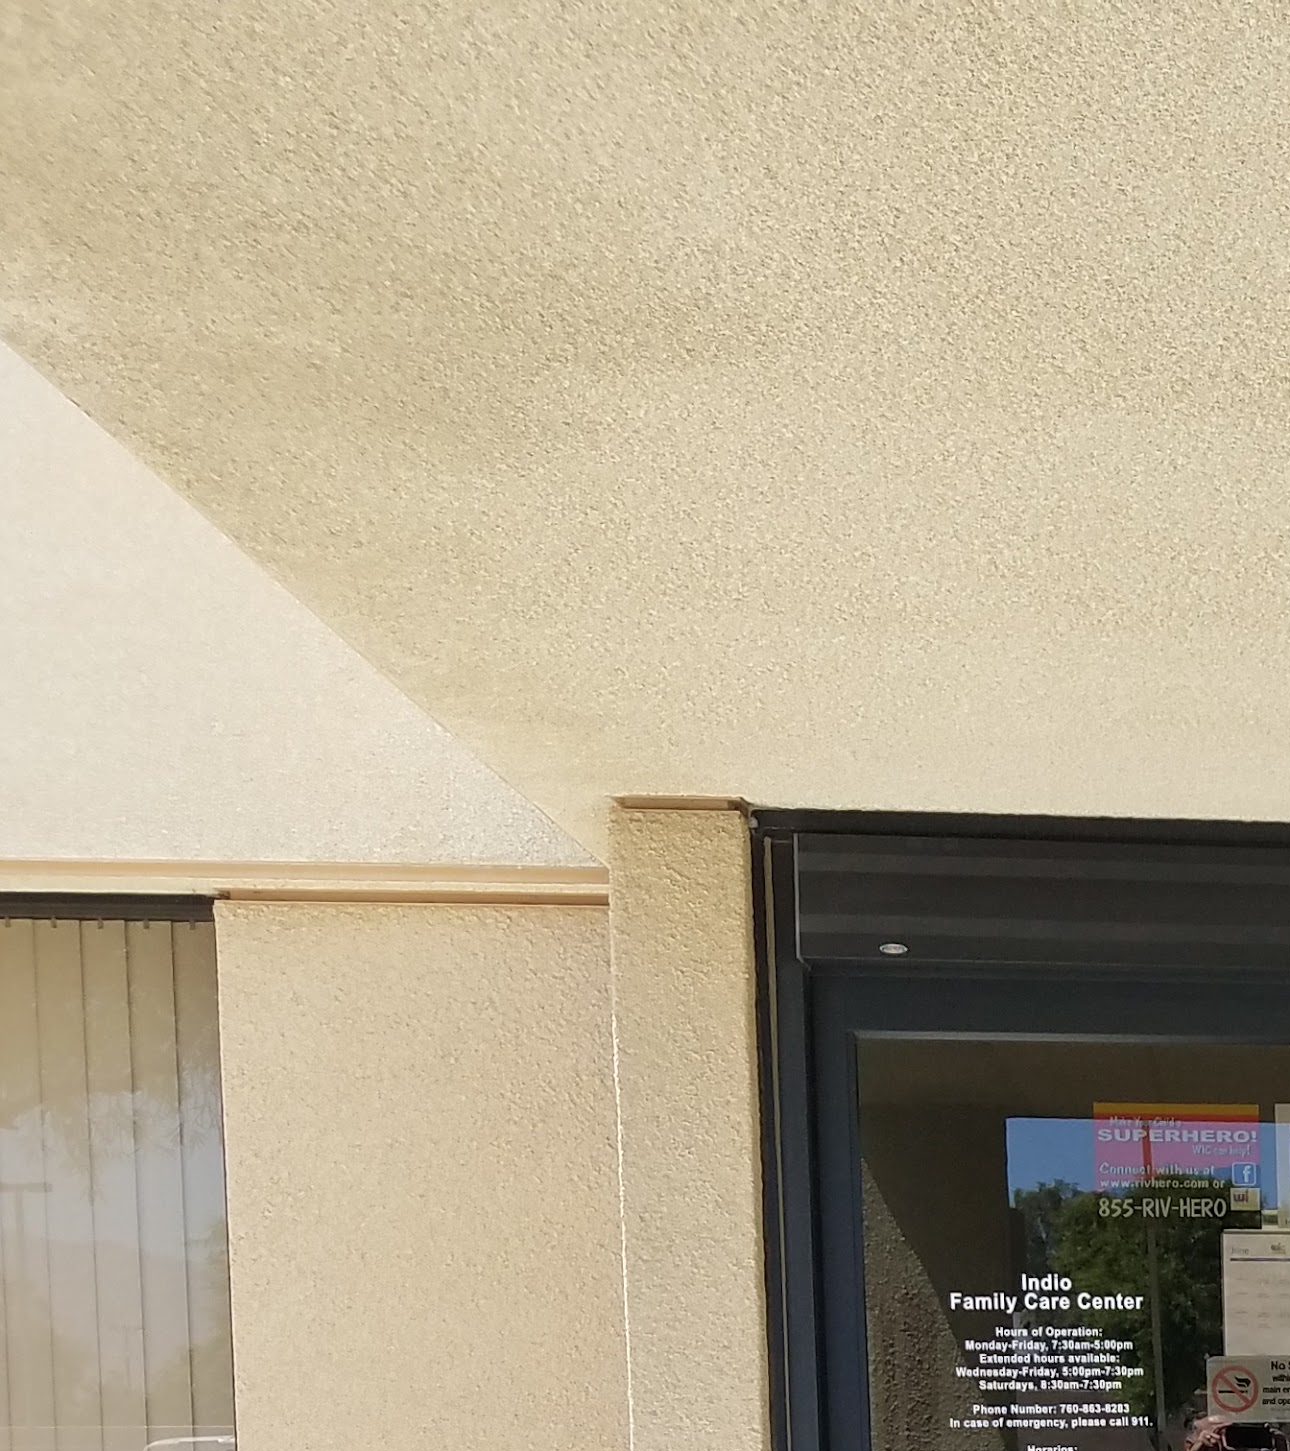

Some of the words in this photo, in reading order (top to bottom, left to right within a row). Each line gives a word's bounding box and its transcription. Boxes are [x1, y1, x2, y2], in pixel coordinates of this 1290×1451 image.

[1098, 1129, 1258, 1143] SUPERHERO!
[1099, 1162, 1151, 1175] Connect
[1156, 1164, 1183, 1175] with
[1186, 1167, 1199, 1175] us
[1203, 1165, 1215, 1175] at
[1100, 1178, 1209, 1189] www.rivhero.com
[1213, 1179, 1226, 1189] or
[1098, 1195, 1227, 1218] 855-RIV-HERO
[1021, 1273, 1072, 1291] Indio
[950, 1292, 1017, 1314] Family
[1024, 1292, 1070, 1310] Care
[1077, 1292, 1143, 1310] Center
[995, 1327, 1028, 1337] Hours
[1031, 1327, 1043, 1337] of
[1046, 1327, 1103, 1339] Operation:
[965, 1340, 1049, 1352] Monday-Friday,
[1052, 1340, 1133, 1351] 7:30am-5:00pm
[979, 1354, 1031, 1364] Extended
[1034, 1354, 1065, 1364] hours
[1068, 1353, 1120, 1364] available:
[1271, 1361, 1286, 1370] No
[955, 1366, 1060, 1379] Wednesday-Friday,
[1062, 1367, 1144, 1378] 5:00pm-7:30pm
[979, 1380, 1038, 1392] Saturdays,
[1040, 1380, 1122, 1391] 8:30am-7:30pm
[1262, 1397, 1276, 1405] and
[972, 1404, 1008, 1415] Phone
[1010, 1404, 1057, 1414] Number:
[950, 1418, 961, 1428] In
[963, 1419, 989, 1428] case
[992, 1417, 1004, 1428] of
[1006, 1418, 1069, 1430] emergency,
[1071, 1417, 1107, 1429] please
[1109, 1416, 1129, 1427] call
[1131, 1416, 1153, 1427] 911.
